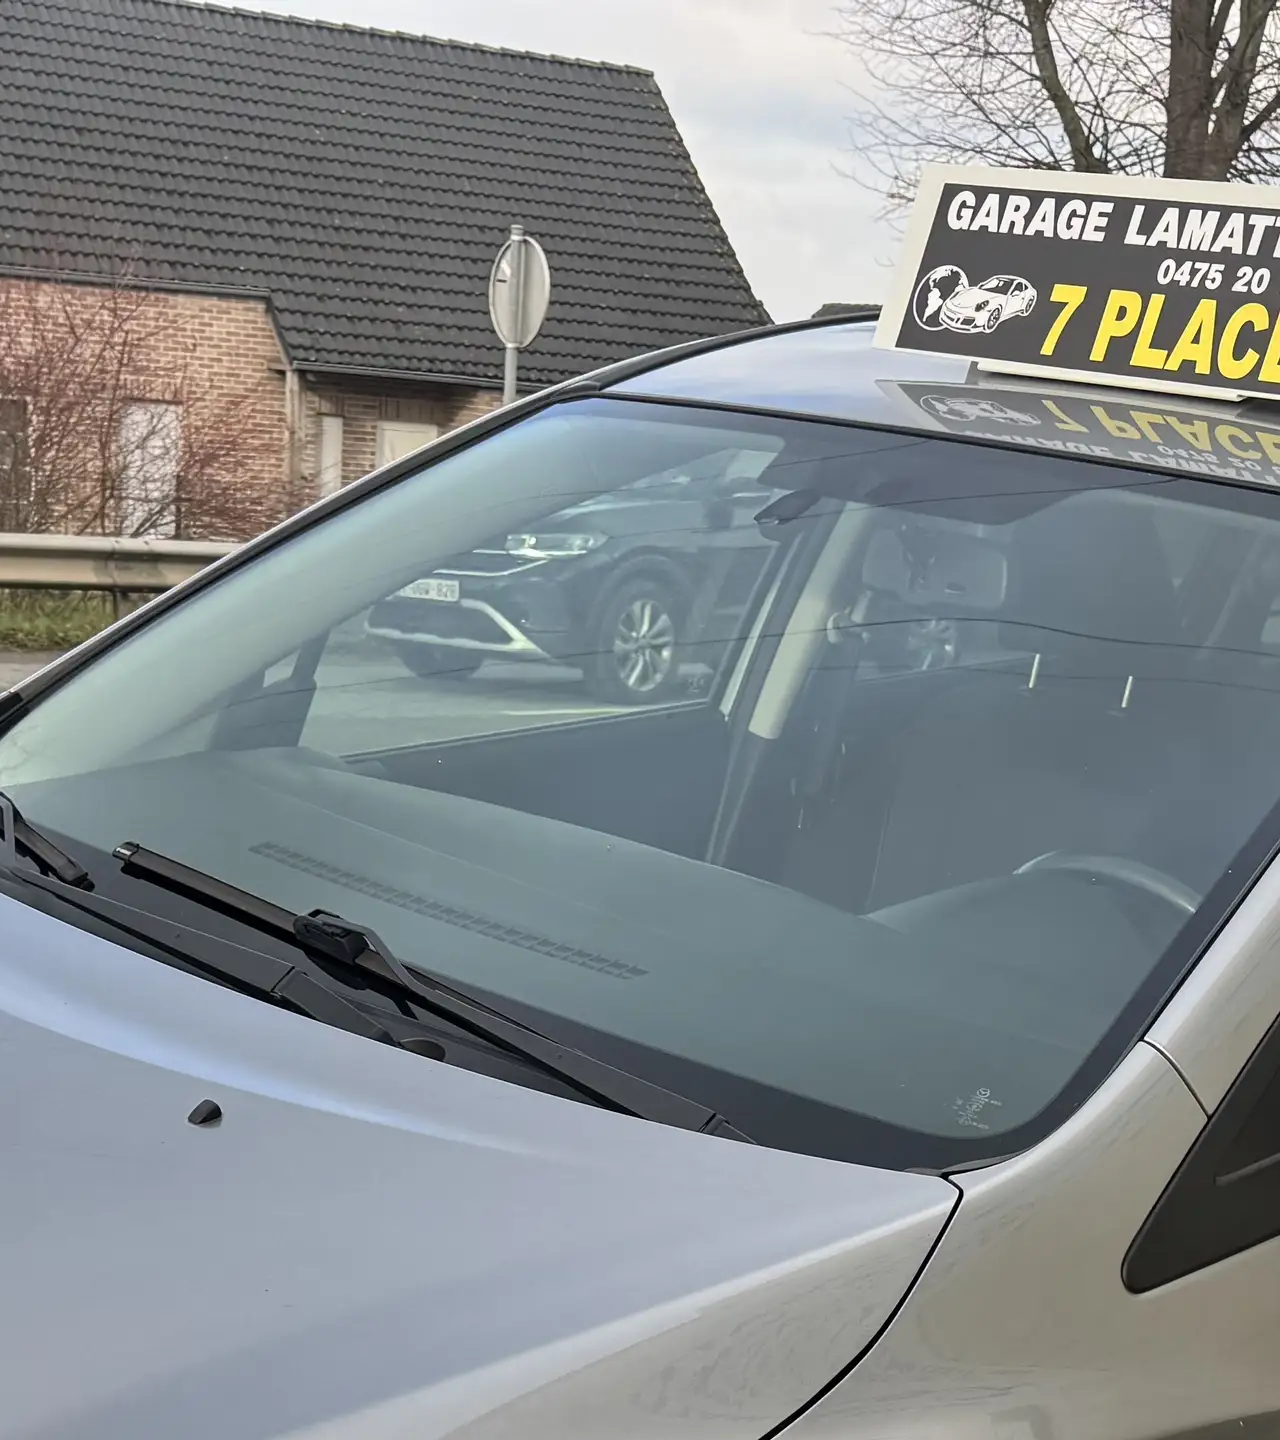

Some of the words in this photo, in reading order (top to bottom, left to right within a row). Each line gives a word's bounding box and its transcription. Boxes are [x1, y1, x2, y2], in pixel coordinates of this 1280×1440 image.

[947, 190, 1114, 243] GARAGE
[1157, 259, 1223, 290] 0475
[1231, 267, 1270, 295] 20
[1039, 284, 1087, 357] 7
